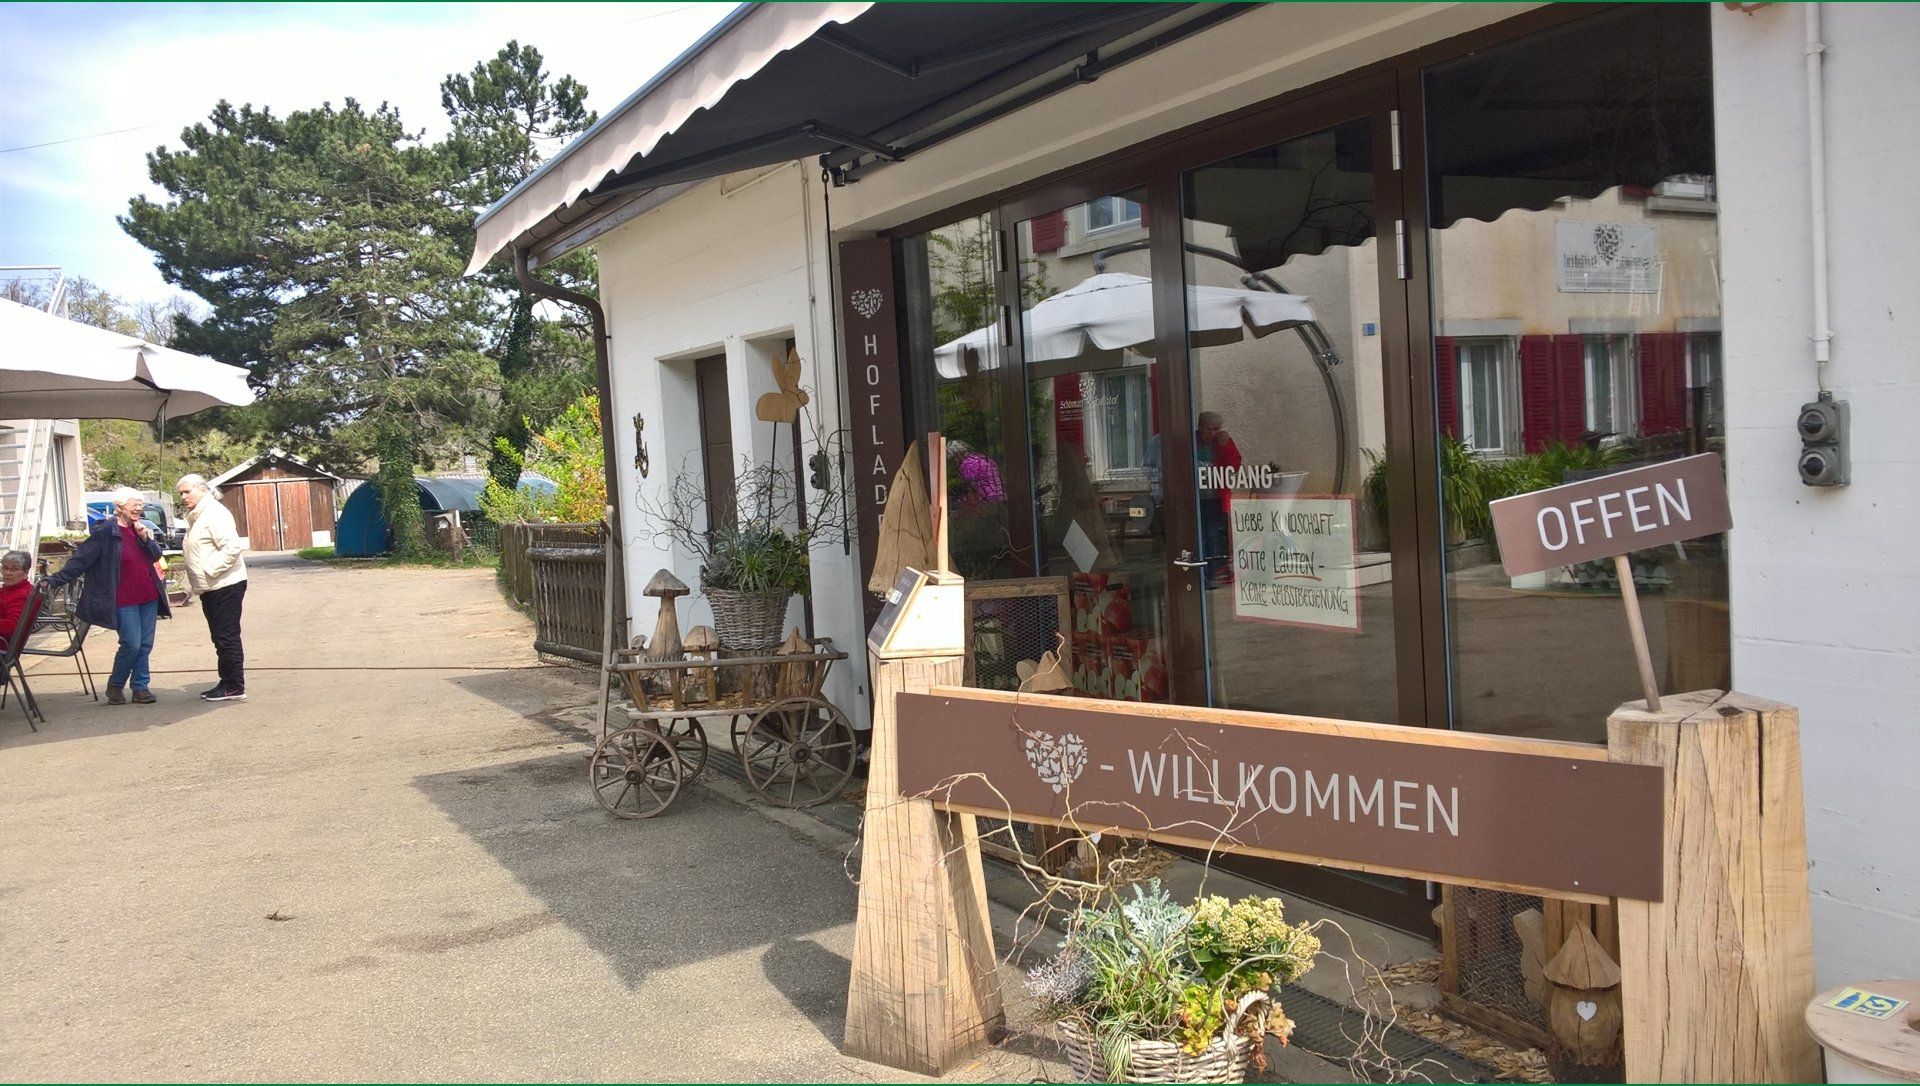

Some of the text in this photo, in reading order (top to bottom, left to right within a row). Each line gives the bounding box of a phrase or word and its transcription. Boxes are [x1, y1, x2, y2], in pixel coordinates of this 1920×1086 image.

[1198, 464, 1273, 490] EINGANG
[1537, 478, 1692, 551] OFFEN
[1238, 549, 1266, 571] BITTE
[1127, 748, 1461, 837] WILLKOMMEN
